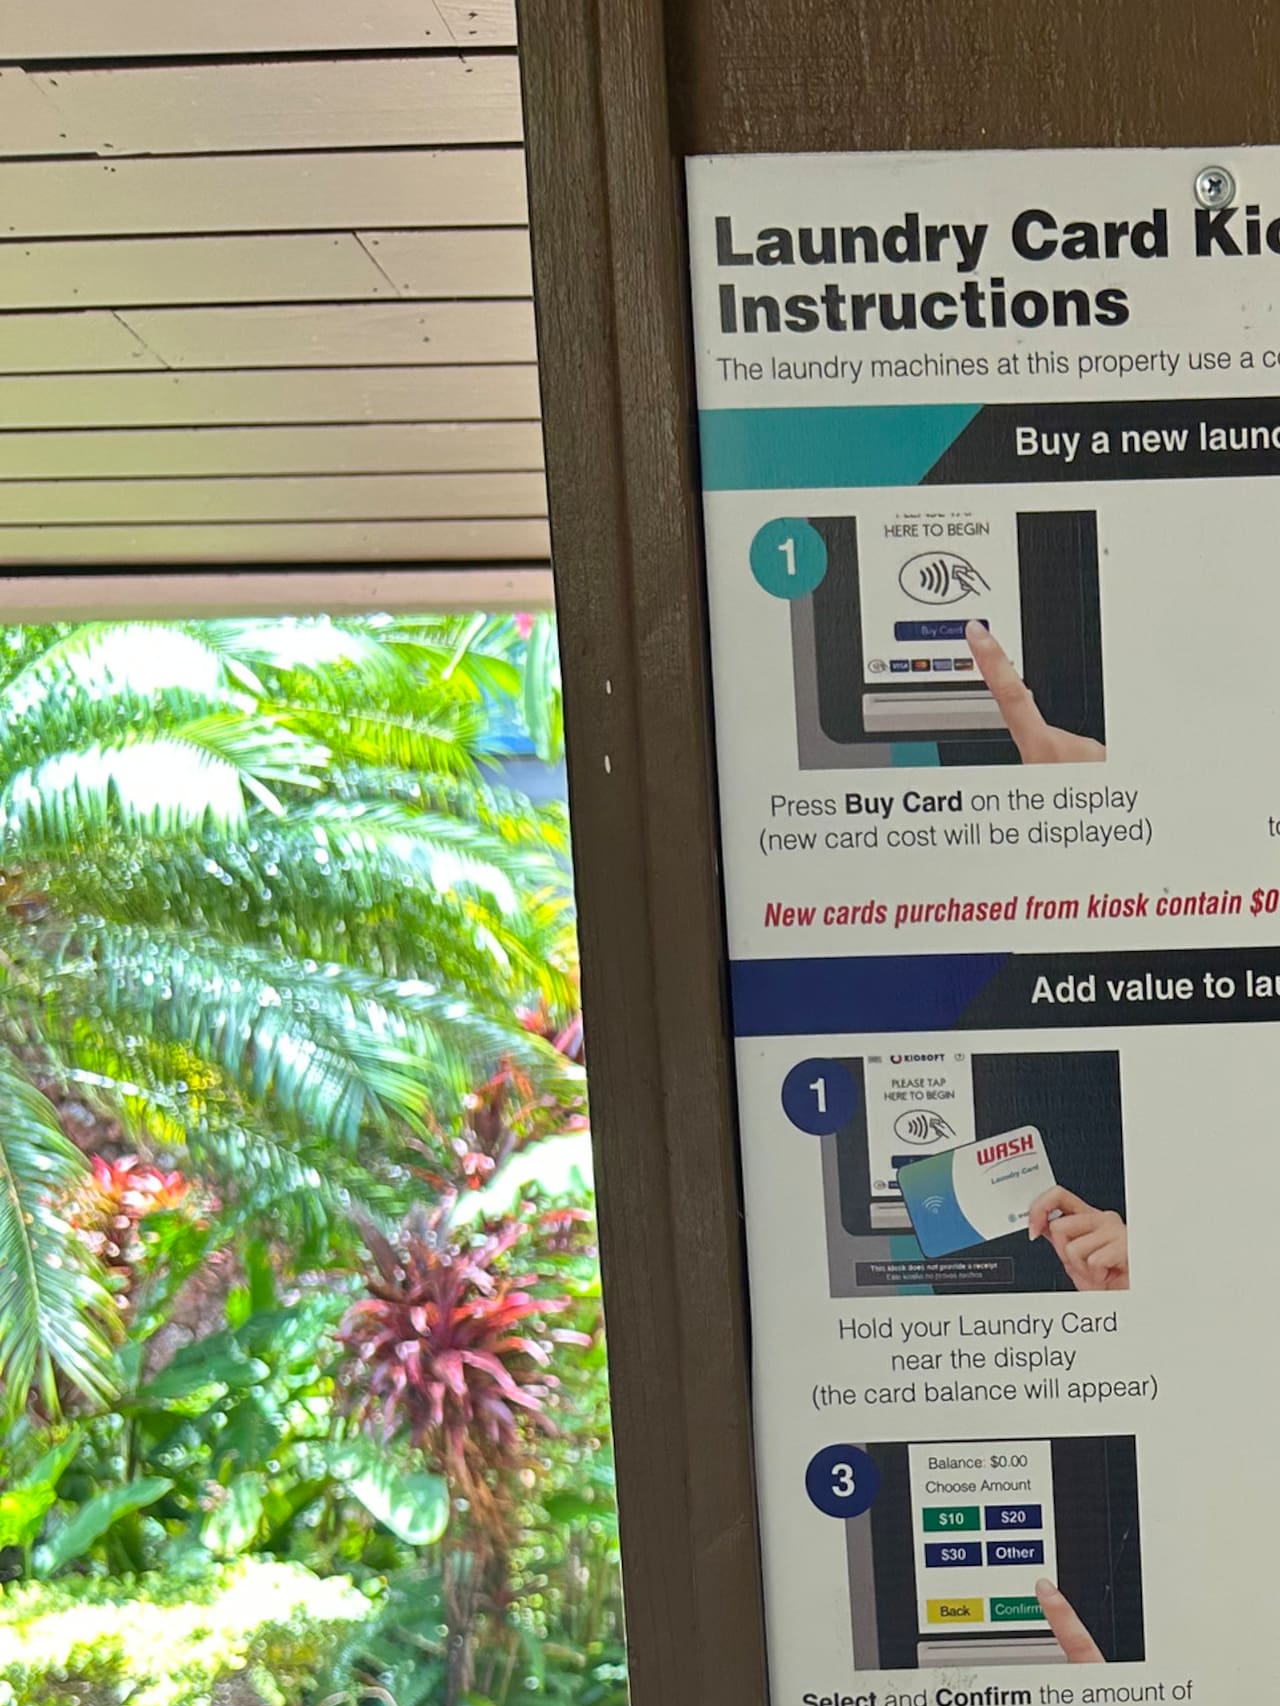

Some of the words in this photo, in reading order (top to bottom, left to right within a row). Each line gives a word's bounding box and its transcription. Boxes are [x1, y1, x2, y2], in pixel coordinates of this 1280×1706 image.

[714, 212, 988, 272] Laundry
[1011, 208, 1168, 260] Card
[718, 277, 1130, 334] Instructions
[717, 357, 763, 382] The
[770, 357, 862, 384] laundry
[871, 354, 989, 378] machines
[997, 355, 1020, 375] at
[1026, 351, 1069, 375] this
[1078, 351, 1180, 377] property
[1187, 350, 1231, 371] use
[1240, 350, 1254, 369] a
[1015, 427, 1080, 463] Buy
[1091, 431, 1110, 455] a
[1121, 426, 1188, 454] new
[884, 524, 919, 538] HERE
[922, 523, 944, 537] TO
[947, 522, 990, 536] BEGIN
[777, 538, 796, 576] 1
[771, 795, 837, 817] Press
[844, 793, 894, 820] Buy
[902, 791, 963, 814] Card
[970, 793, 1000, 812] on
[1008, 789, 1044, 810] the
[1052, 786, 1138, 814] display
[764, 902, 816, 928] New
[823, 899, 887, 926] cards
[895, 896, 1018, 928] purchased
[1024, 895, 1078, 920] from
[1087, 893, 1148, 918] kiosk
[1156, 891, 1242, 917] contain
[1250, 888, 1279, 917] $0
[1031, 975, 1096, 1005] Add
[1106, 973, 1193, 1001] value
[1203, 971, 1235, 998] to
[808, 1077, 827, 1113] 1
[976, 1134, 1034, 1166] WASH
[839, 1317, 893, 1340] Hold
[900, 1316, 951, 1343] your
[959, 1314, 1055, 1339] Laundry
[1061, 1311, 1118, 1335] Card
[891, 1351, 942, 1371] near
[950, 1349, 986, 1370] the
[993, 1346, 1077, 1372] display
[831, 1463, 855, 1498] 3
[925, 1480, 977, 1494] Choose
[980, 1479, 1032, 1492] Amount
[938, 1512, 964, 1526] $10
[1001, 1510, 1026, 1524] $20
[941, 1548, 966, 1562] $30
[995, 1546, 1035, 1559] Other
[940, 1605, 971, 1617] Back
[1039, 1684, 1074, 1705] the
[1081, 1683, 1165, 1704] amount
[1171, 1679, 1194, 1701] of
